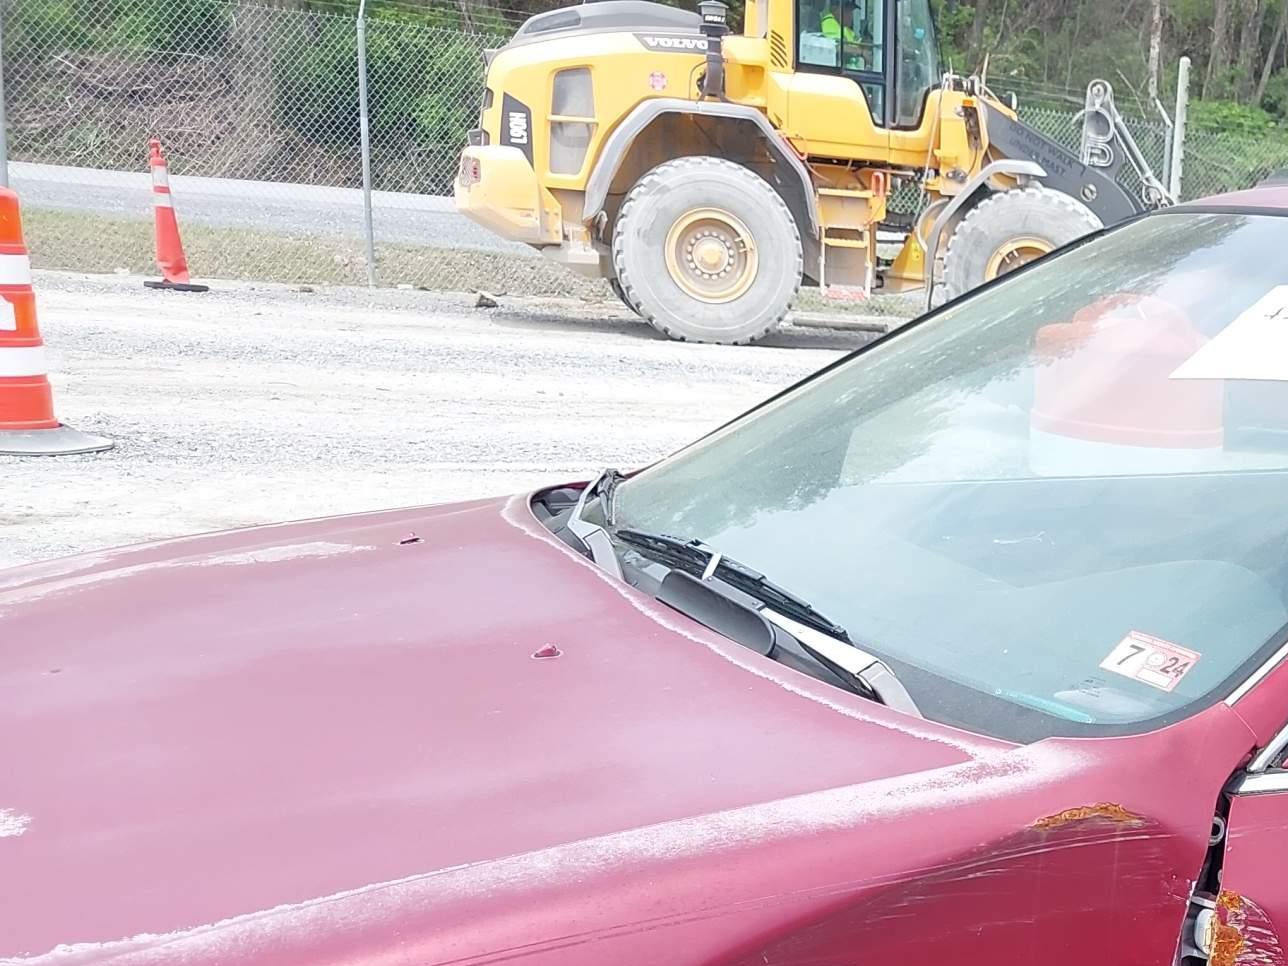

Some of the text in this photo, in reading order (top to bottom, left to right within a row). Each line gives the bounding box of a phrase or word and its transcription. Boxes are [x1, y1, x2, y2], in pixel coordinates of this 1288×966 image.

[642, 36, 709, 50] VOLVO
[508, 111, 528, 144] L90H
[1025, 133, 1047, 149] NOT
[1048, 146, 1073, 169] WALK
[1116, 643, 1147, 666] 7
[1159, 656, 1191, 678] 24
